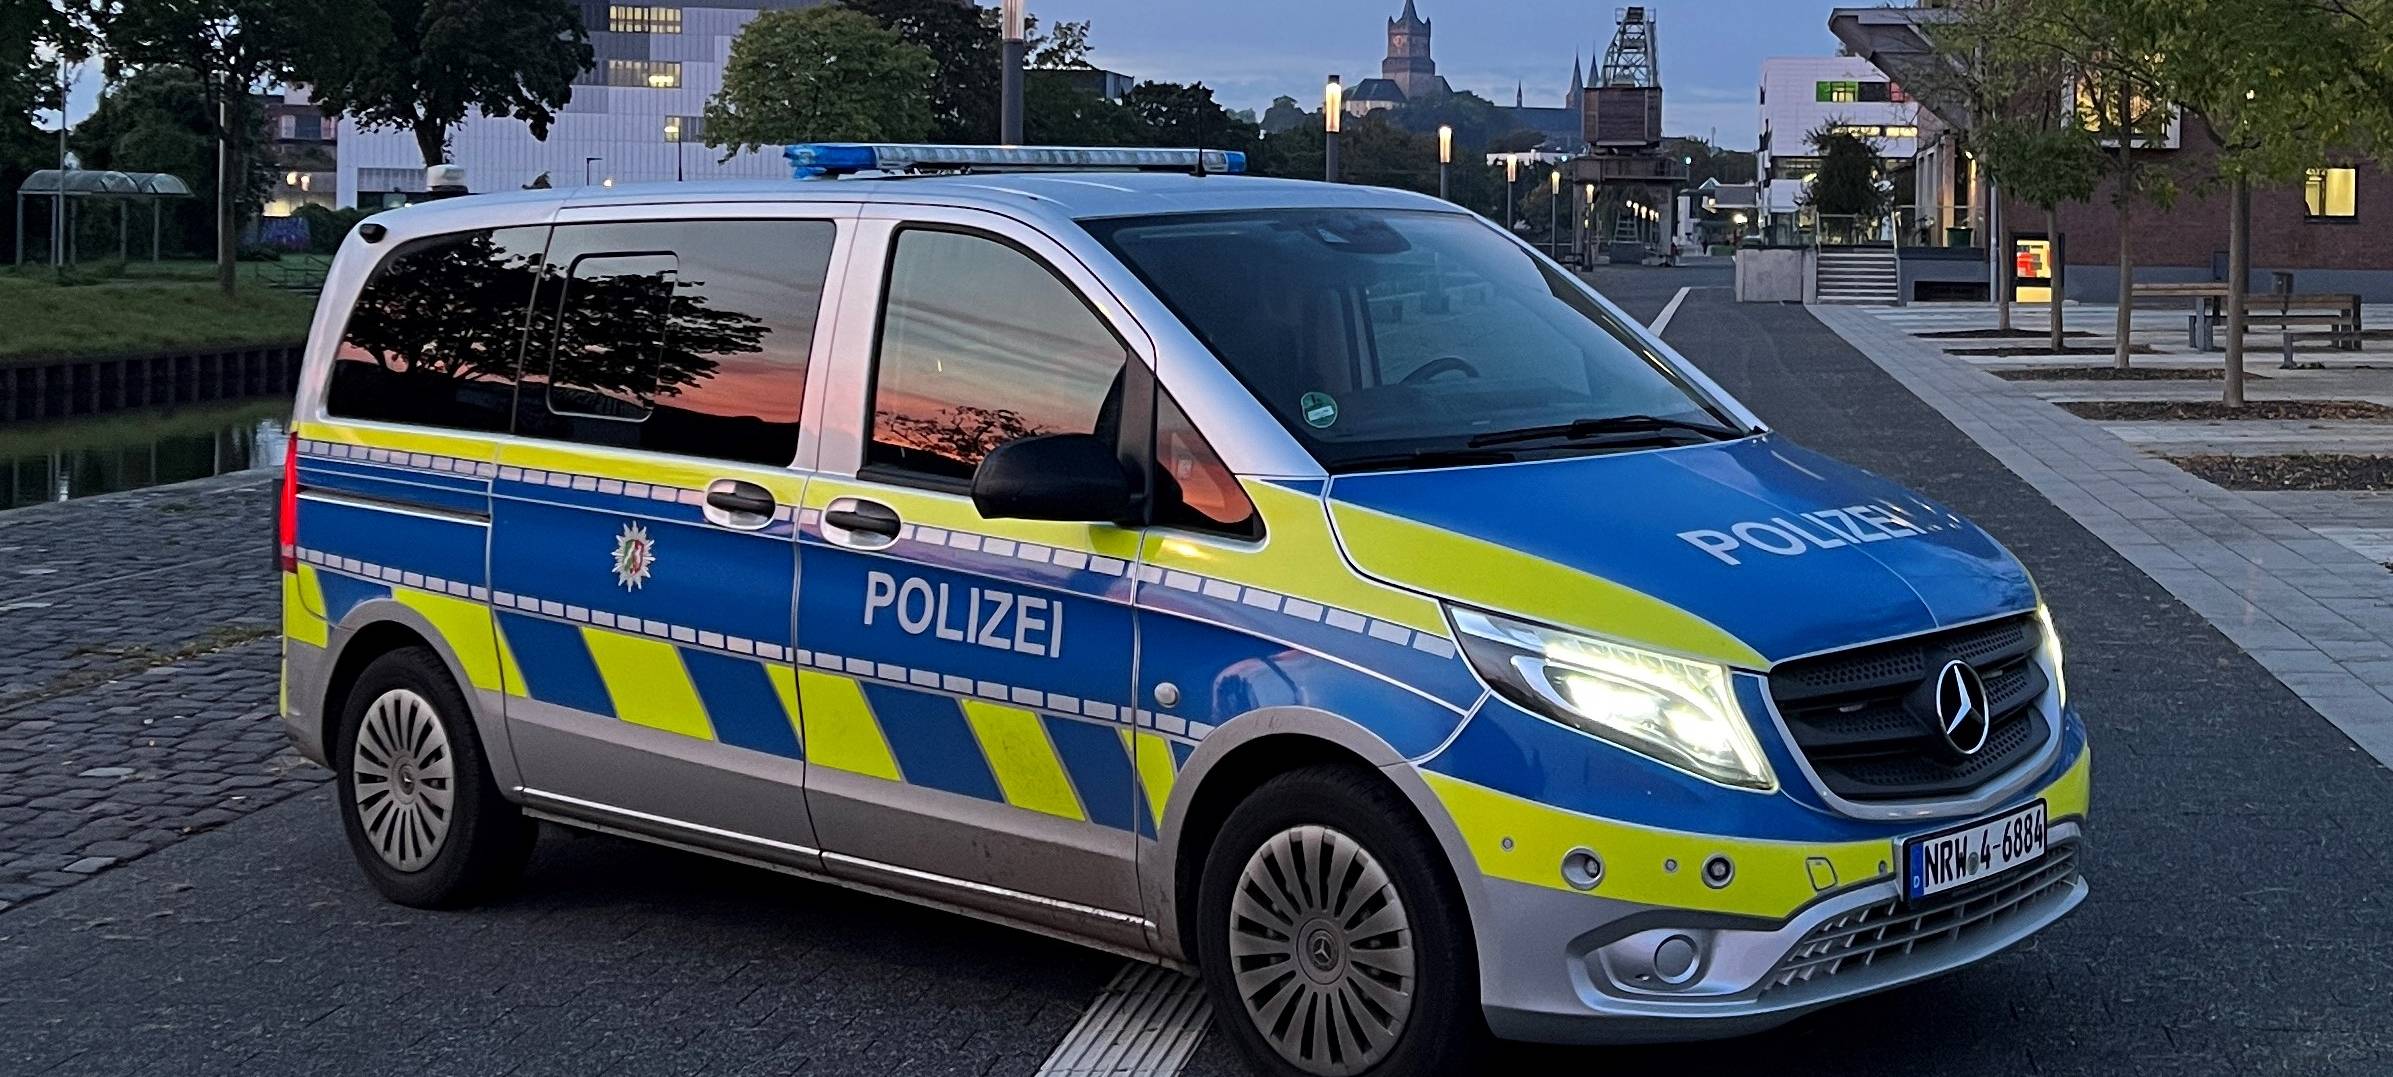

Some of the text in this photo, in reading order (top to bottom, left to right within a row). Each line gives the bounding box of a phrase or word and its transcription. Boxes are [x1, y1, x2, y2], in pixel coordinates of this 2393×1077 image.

[1676, 504, 1928, 566] POLIZEI
[864, 570, 1063, 658] POLIZEI
[1924, 835, 1968, 888] NRW
[1980, 809, 2043, 870] 4-6884
